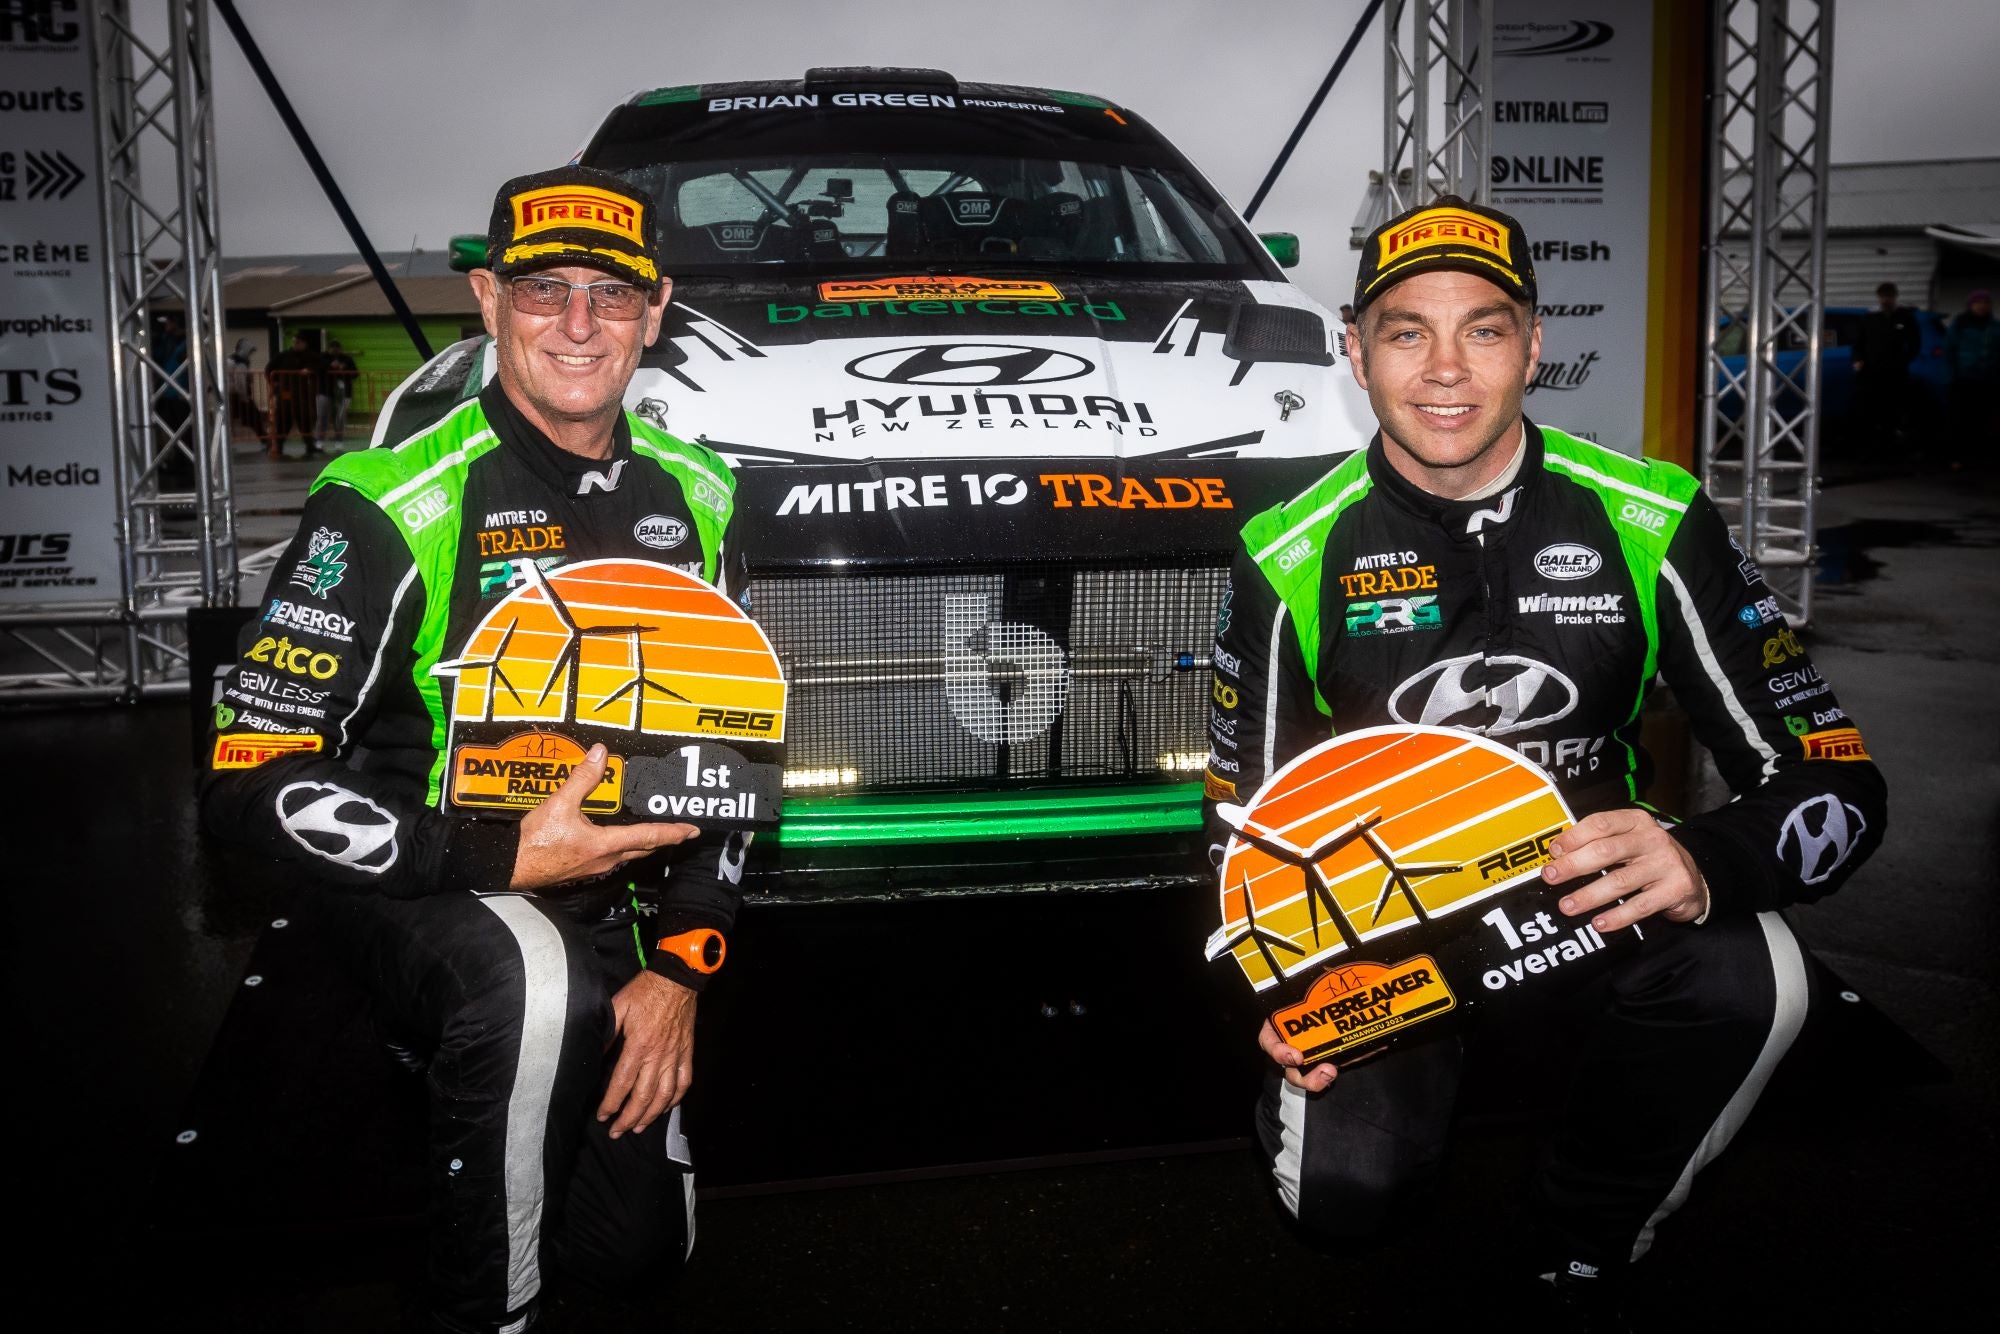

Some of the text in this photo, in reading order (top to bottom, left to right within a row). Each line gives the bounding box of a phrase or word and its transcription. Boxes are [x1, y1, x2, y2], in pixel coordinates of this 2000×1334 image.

[708, 93, 1065, 113] BRIAN GREEN PROPERTIES
[1494, 101, 1571, 123] ENTRAL
[1103, 108, 1128, 126] 1
[1491, 155, 1604, 183] ONLINE
[522, 194, 635, 232] PIRELLI
[960, 202, 991, 214] OMP
[721, 228, 754, 239] OMP
[1389, 215, 1500, 255] PIRELLI
[1532, 240, 1611, 262] tFish
[766, 300, 1128, 324] bartercard
[812, 393, 1154, 429] HYUNDAI
[814, 419, 1158, 443] NEW ZEALAND
[8, 462, 100, 487] Media
[775, 473, 1234, 516] MITRE 10 TRADE
[404, 489, 449, 528] OMP
[485, 509, 547, 528] MITRE 10
[1622, 504, 1666, 530] OMP
[477, 526, 566, 556] TRADE
[639, 525, 685, 536] BAILEY
[1279, 539, 1311, 570] OMP
[1354, 550, 1418, 571] MITRE 10
[1539, 554, 1596, 567] BAILEY
[1340, 565, 1438, 597] TRADE
[1560, 565, 1593, 573] ZEALAND
[275, 601, 356, 635] ENERGY
[1346, 596, 1442, 631] PRG
[1555, 612, 1626, 624] Brake Pads
[244, 636, 338, 680] etco
[274, 702, 296, 713] LESS
[297, 706, 326, 719] ENERGY
[696, 708, 775, 731] R2G
[217, 741, 317, 762] PIRE
[1807, 734, 1865, 758] PIRE
[463, 757, 616, 784] DAYBREAR
[680, 746, 731, 789] 1st
[505, 796, 546, 805] MANAWAT
[647, 792, 756, 819] overall
[1481, 907, 1559, 950] 1st
[1482, 923, 1606, 990] overall
[1283, 968, 1435, 1037] DAYBREAKER
[1333, 1000, 1393, 1035] RALLY
[1341, 1023, 1385, 1044] MANAWATU
